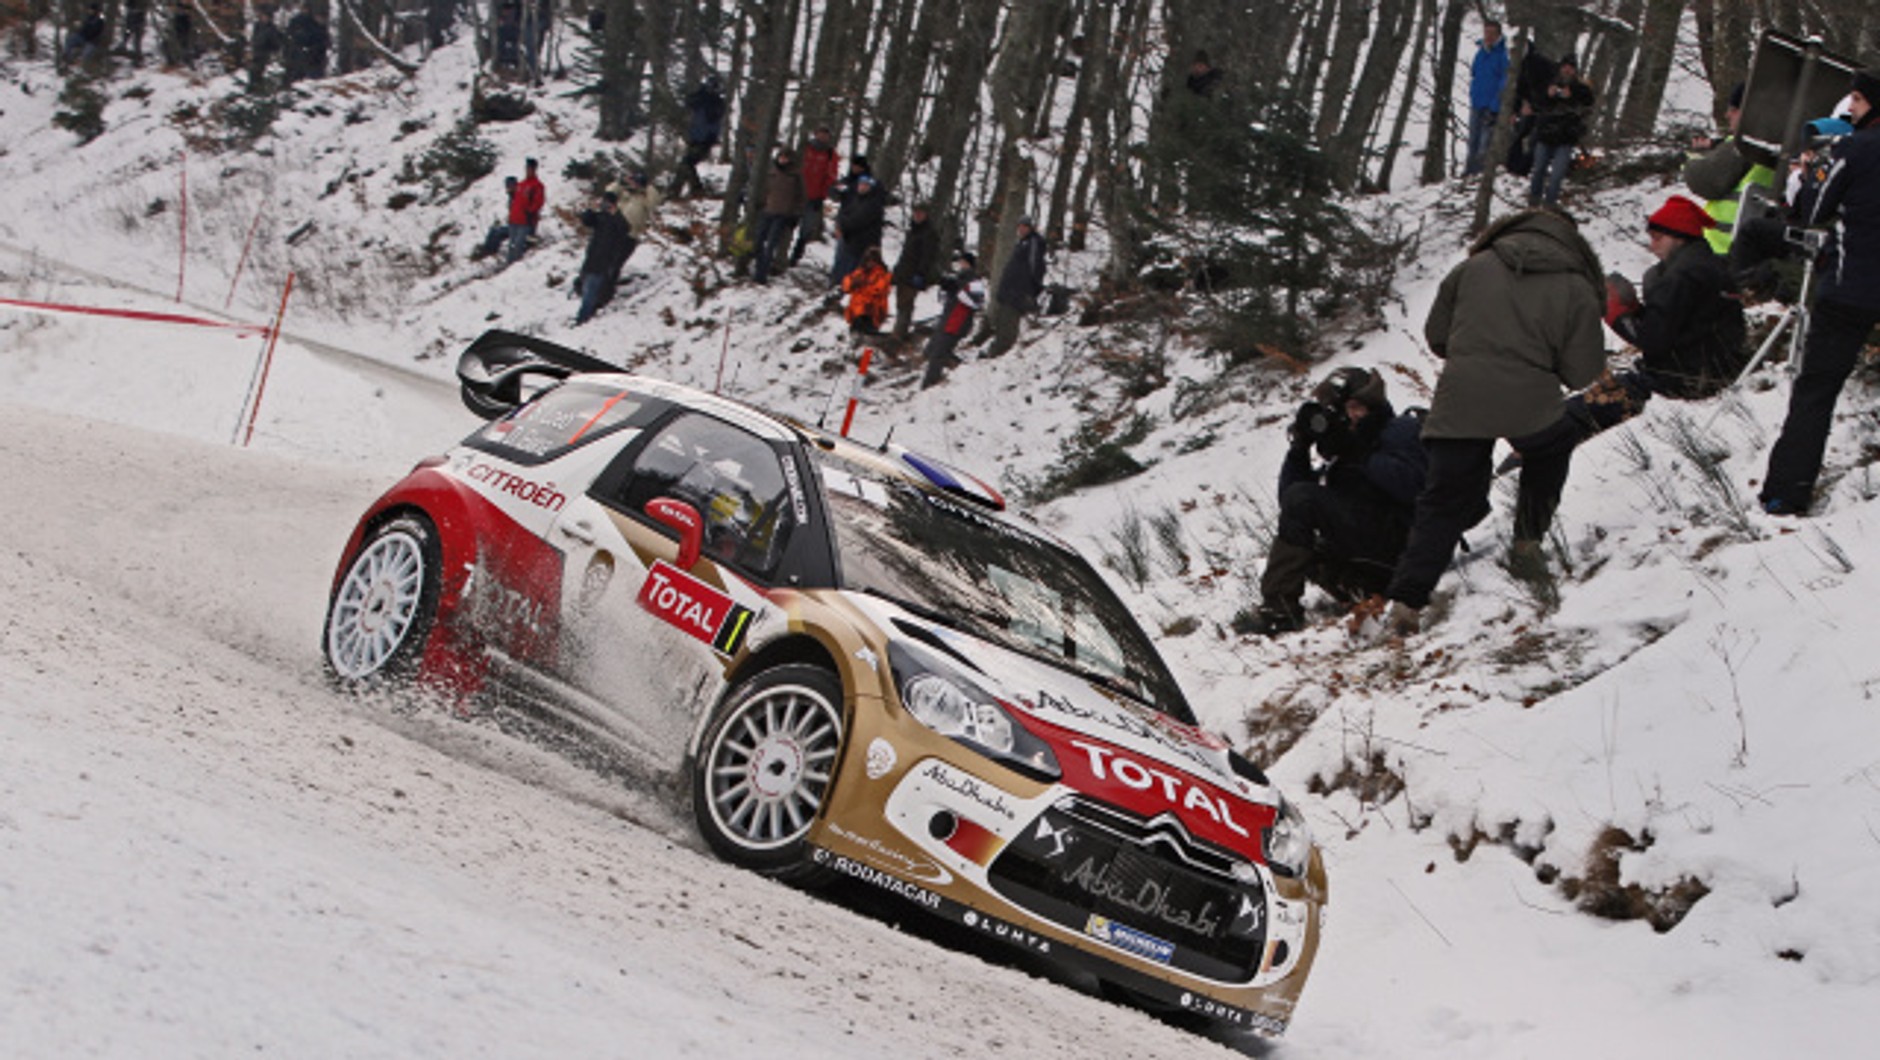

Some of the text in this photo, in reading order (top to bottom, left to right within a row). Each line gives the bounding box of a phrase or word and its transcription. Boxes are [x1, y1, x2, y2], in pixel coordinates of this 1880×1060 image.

[648, 572, 715, 633] TOTAL
[725, 610, 751, 653] 1
[1070, 739, 1250, 838] TOTAL
[1134, 879, 1222, 938] Dhabi
